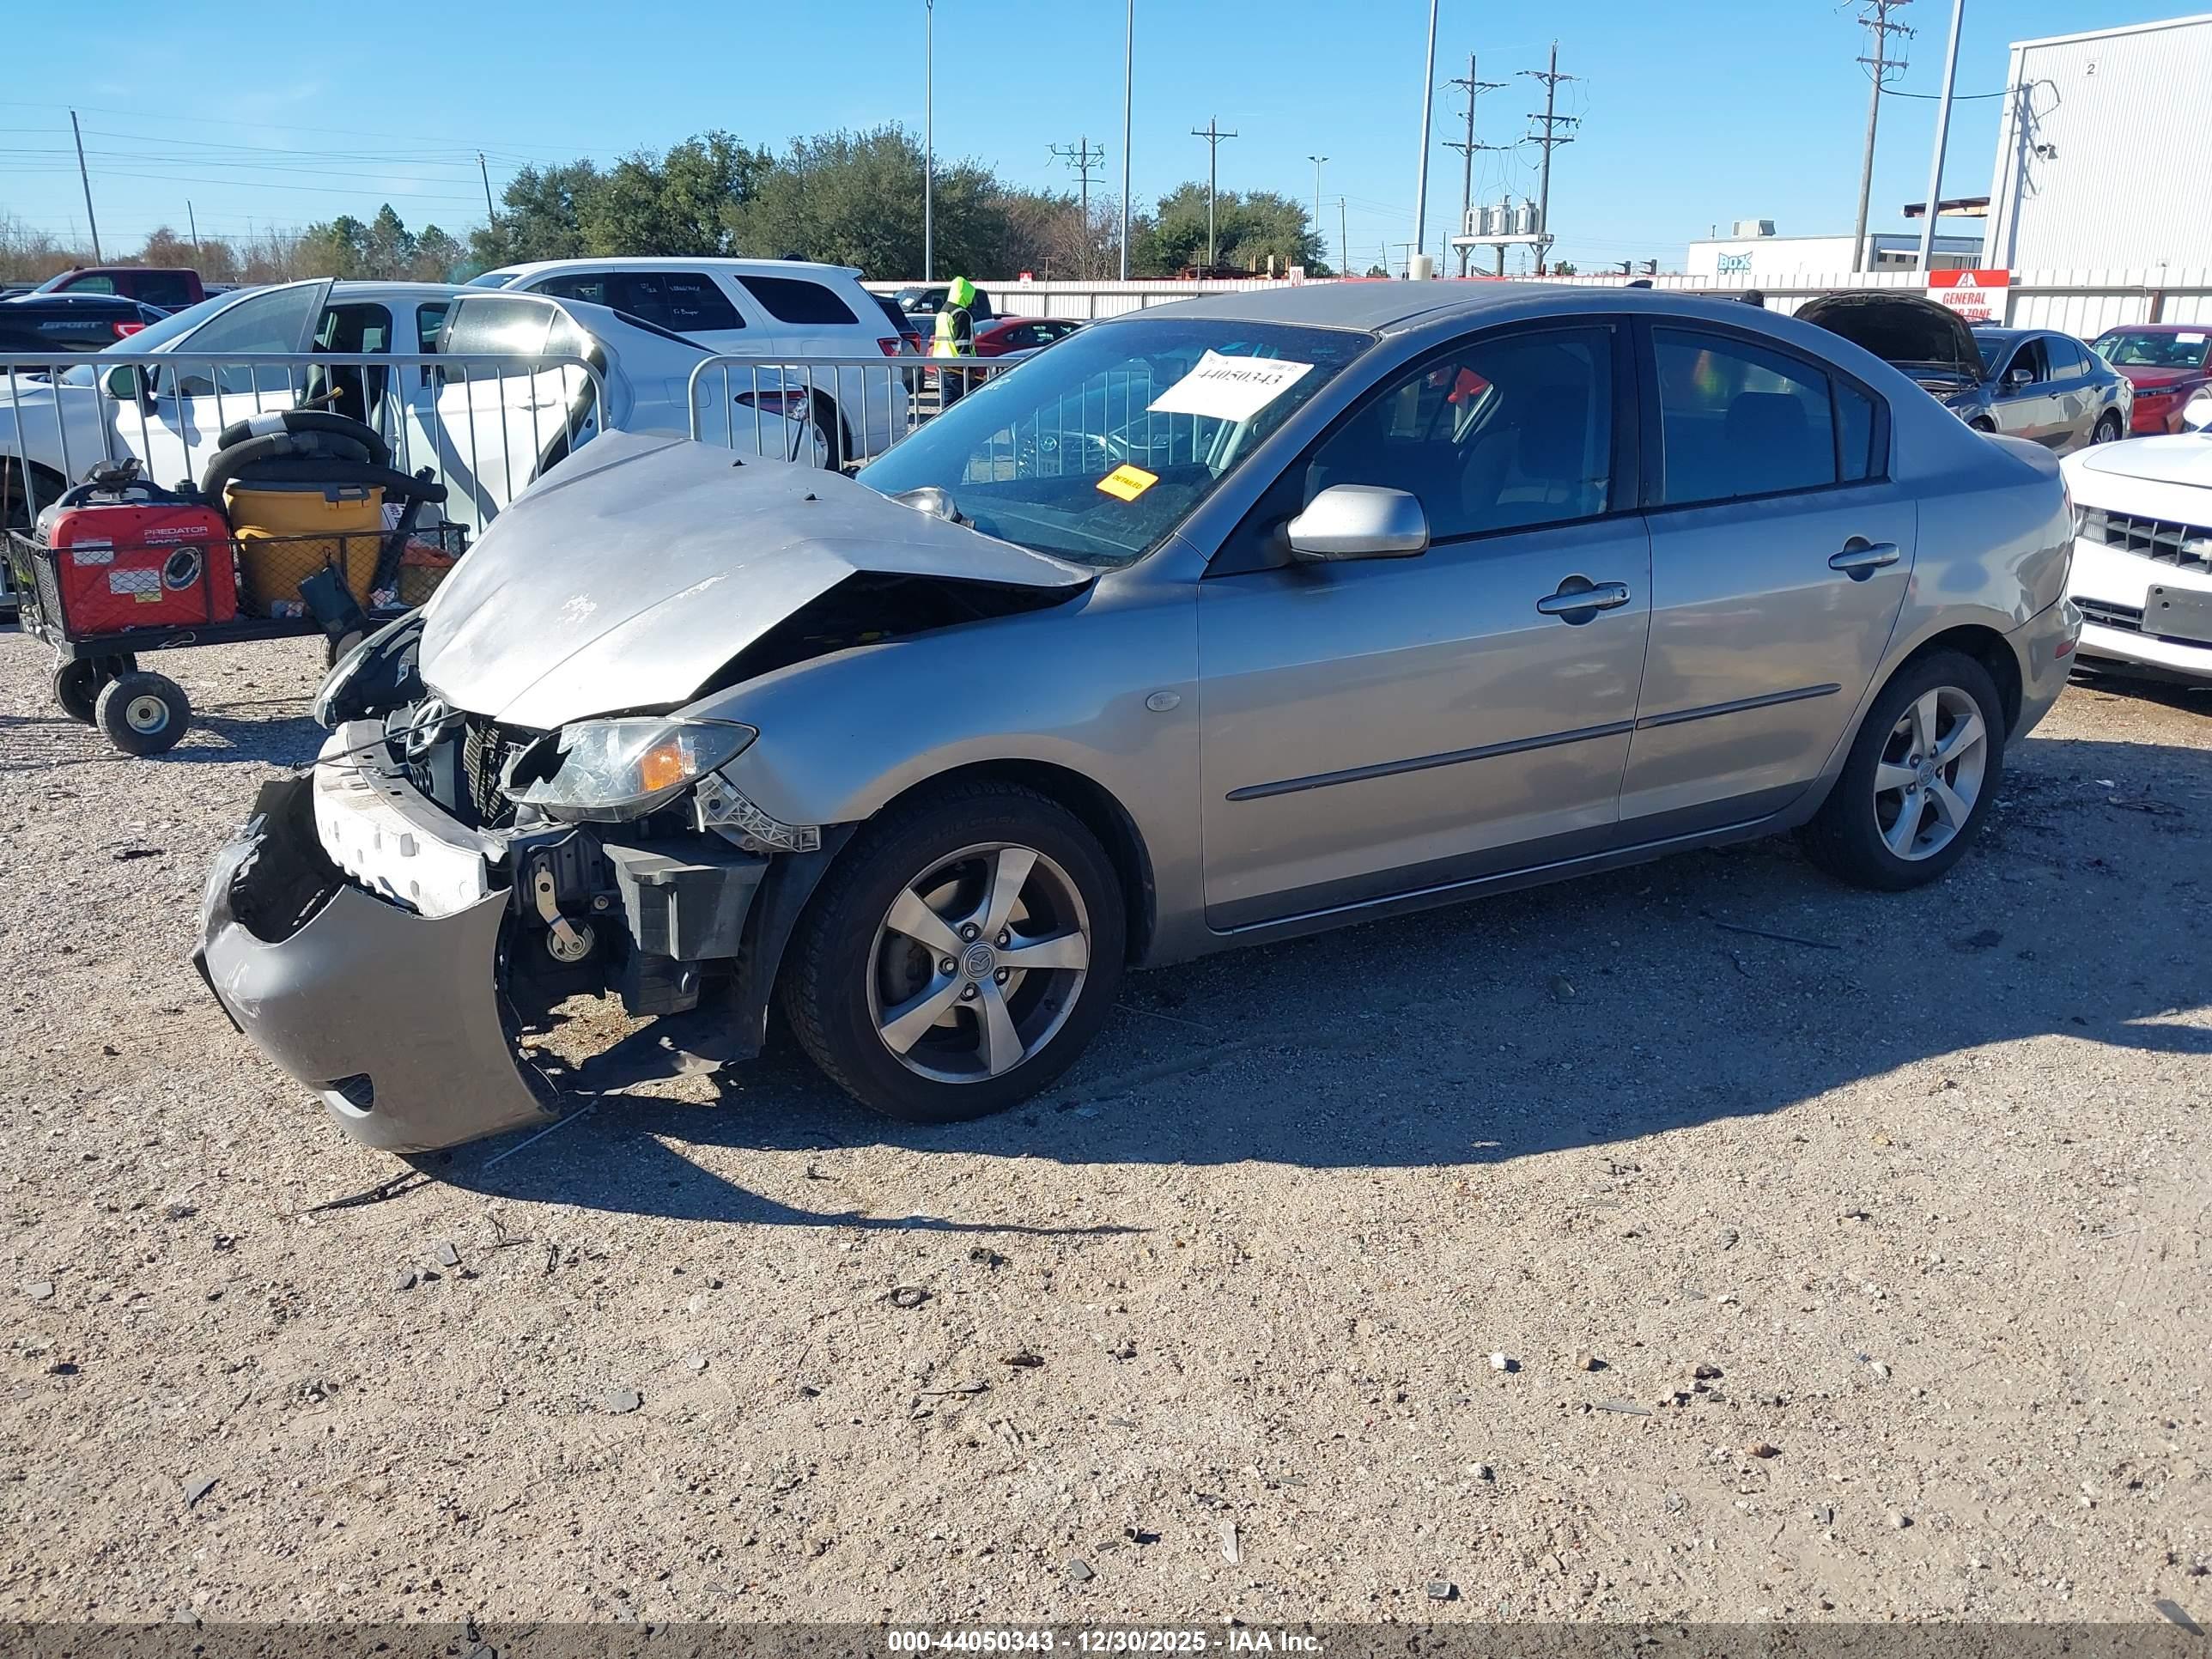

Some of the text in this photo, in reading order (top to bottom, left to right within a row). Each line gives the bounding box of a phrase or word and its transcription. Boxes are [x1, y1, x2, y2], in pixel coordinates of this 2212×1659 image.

[2087, 64, 2095, 75] 2
[1717, 251, 1753, 270] BOX
[1942, 292, 1986, 305] GENERAL
[38, 321, 103, 330] SPORT
[1198, 369, 1283, 385] 44050343
[143, 526, 208, 536] PREDATOR
